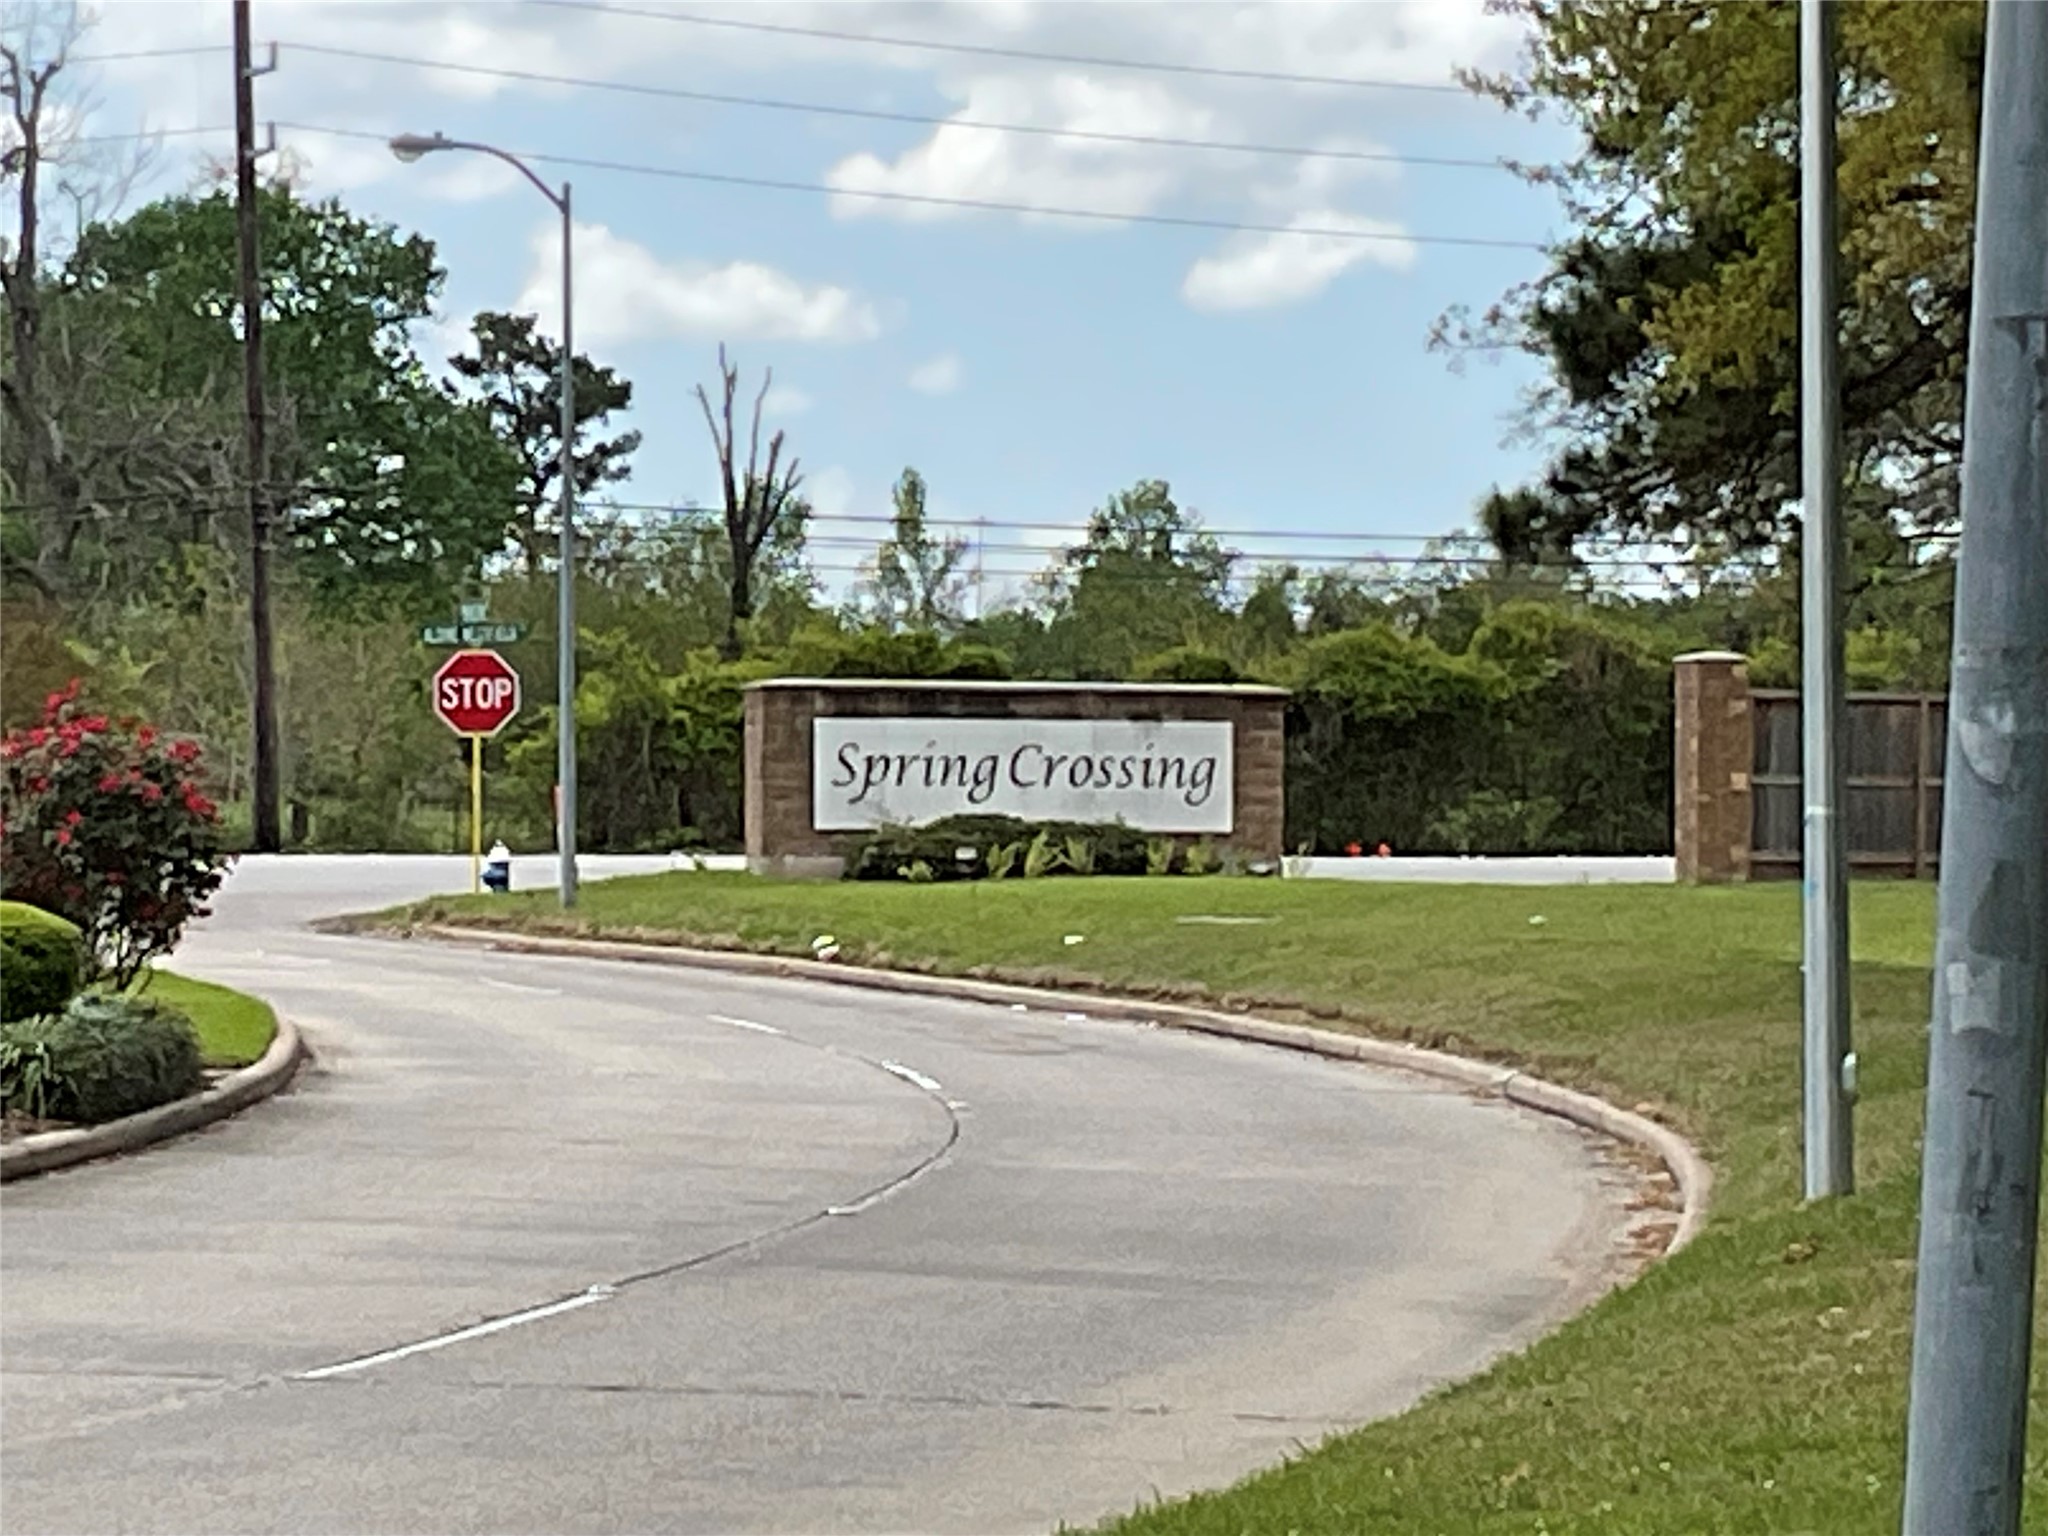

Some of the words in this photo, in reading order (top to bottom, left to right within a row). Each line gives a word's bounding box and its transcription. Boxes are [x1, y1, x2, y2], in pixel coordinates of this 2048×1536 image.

[441, 677, 512, 709] STOP
[831, 741, 1000, 804] Spring
[1009, 743, 1217, 806] Crossing
